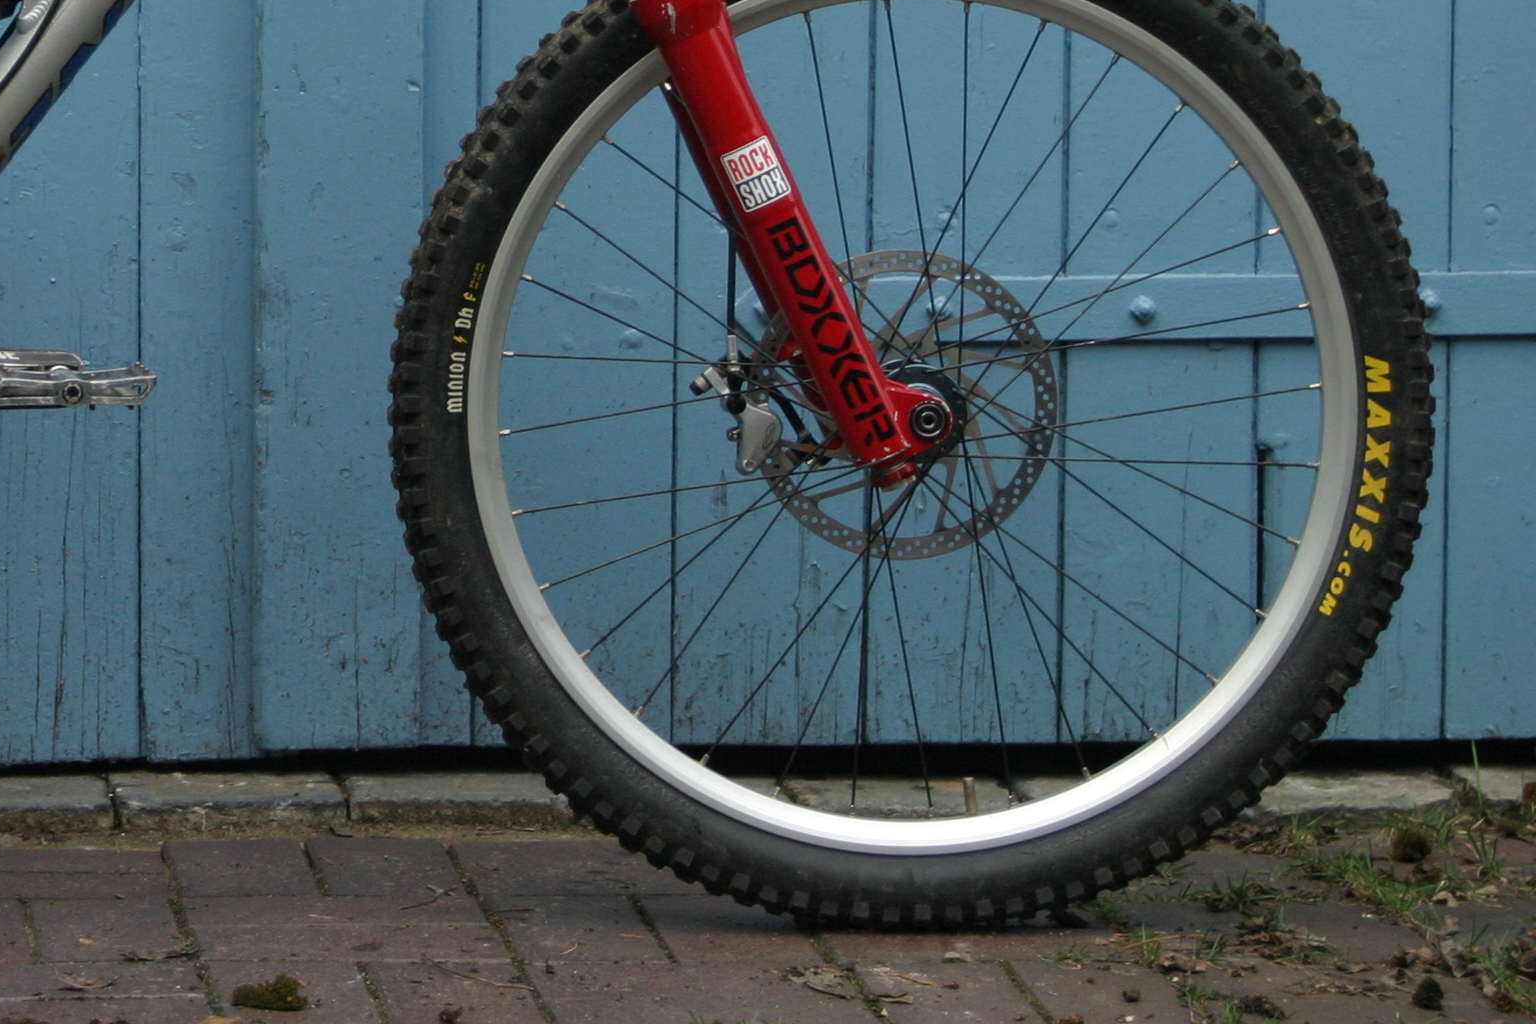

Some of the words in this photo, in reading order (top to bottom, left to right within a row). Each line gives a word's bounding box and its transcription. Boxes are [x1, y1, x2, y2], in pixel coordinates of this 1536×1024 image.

[726, 142, 776, 183] ROCK
[739, 169, 788, 209] SHOX
[766, 216, 897, 447] BOXXER
